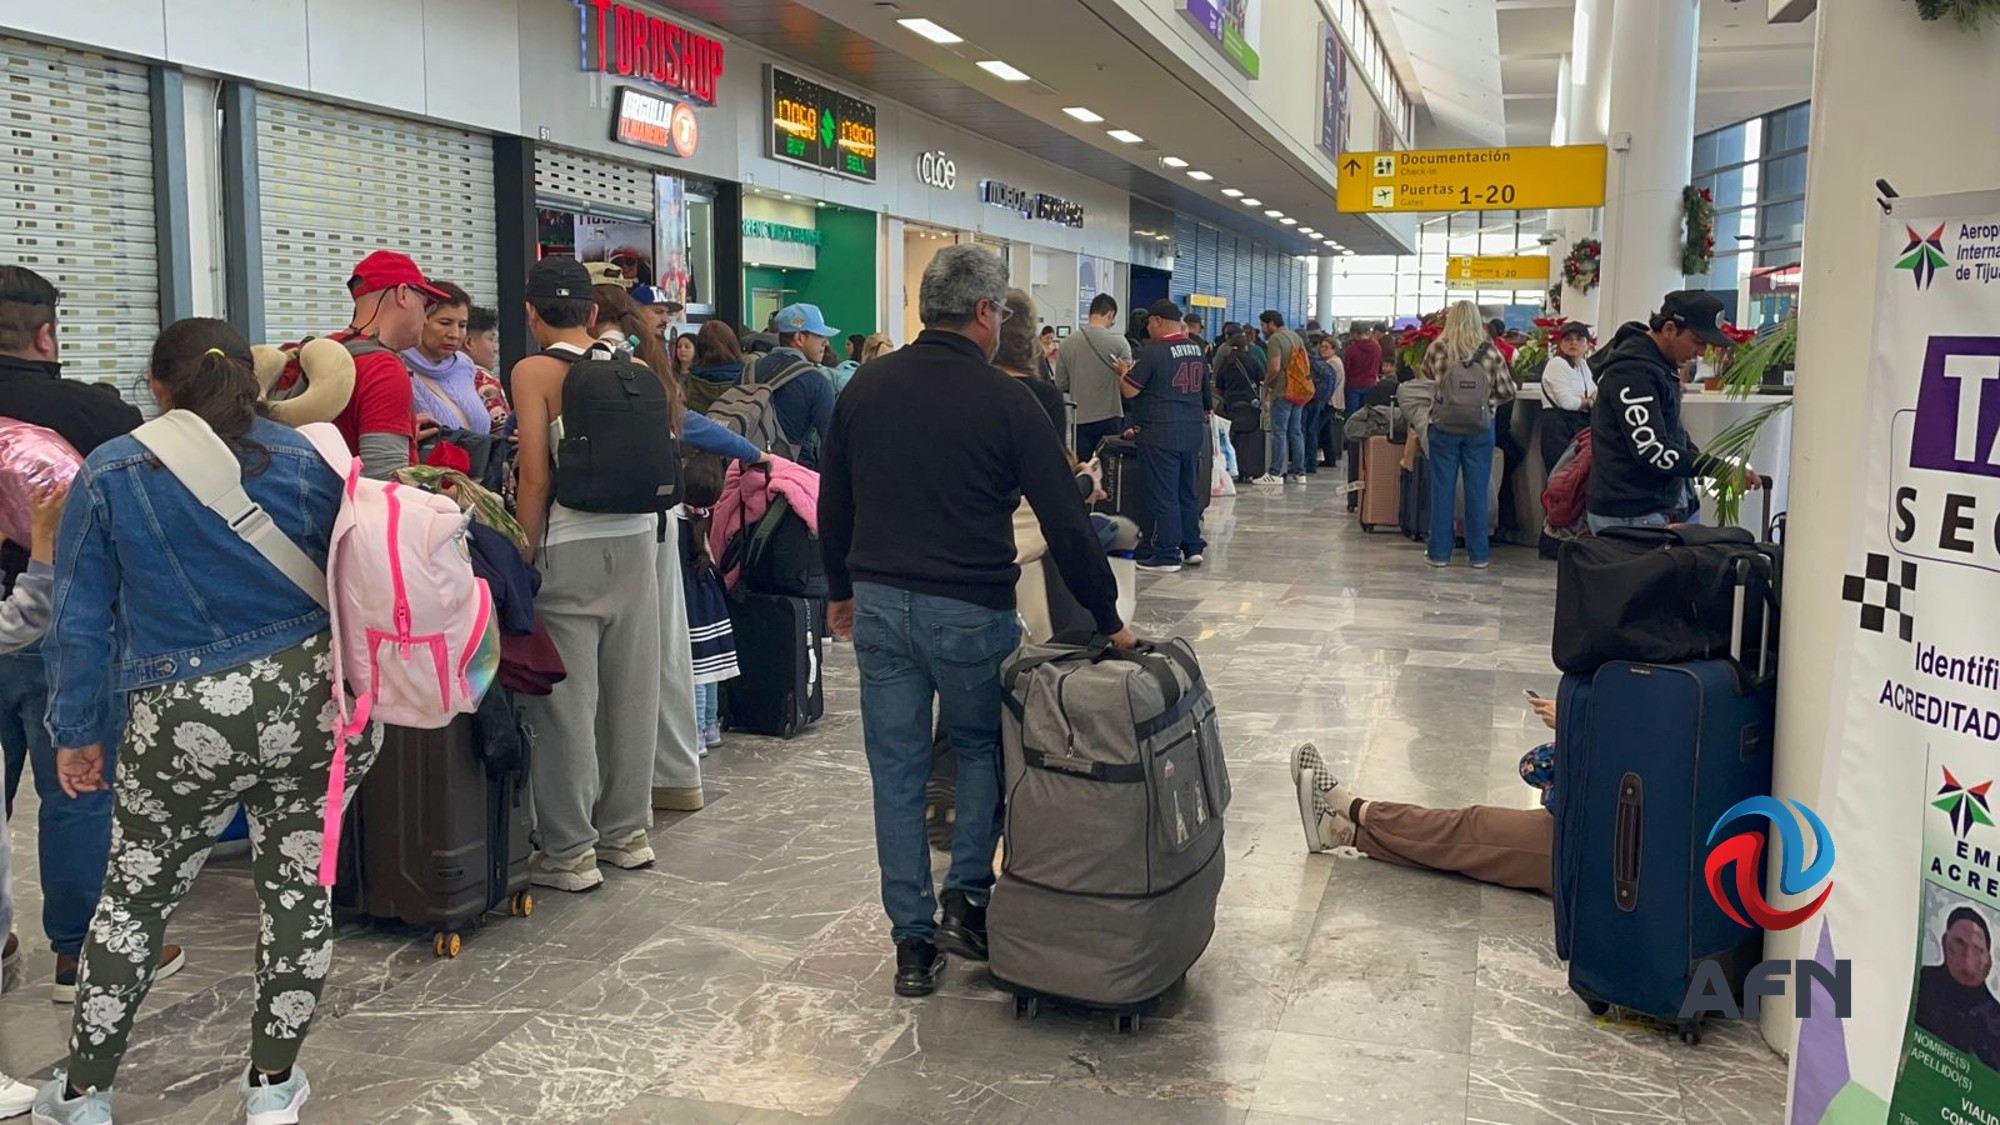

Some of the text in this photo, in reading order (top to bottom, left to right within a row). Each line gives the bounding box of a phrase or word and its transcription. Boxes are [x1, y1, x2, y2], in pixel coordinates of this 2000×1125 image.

[590, 0, 725, 107] TOROSHOP
[1400, 150, 1511, 165] Documentación
[1400, 168, 1437, 176] Check-in
[1400, 183, 1516, 205] Puertas 1-20
[1959, 223, 2000, 242] Aerop
[1494, 269, 1517, 278] 1-20
[1955, 263, 2000, 284] de Tiju
[1171, 361, 1203, 394] 40
[1943, 353, 2000, 466] T
[1619, 386, 1680, 471] Jeans
[1895, 486, 2000, 557] SE
[1879, 679, 2000, 741] ACREDITAD
[1956, 840, 2000, 873] EM
[1931, 856, 2000, 898] ACRE
[1910, 1047, 1973, 1094] APELLIDO(S)
[1914, 1030, 1971, 1074] NOMBRE(S)
